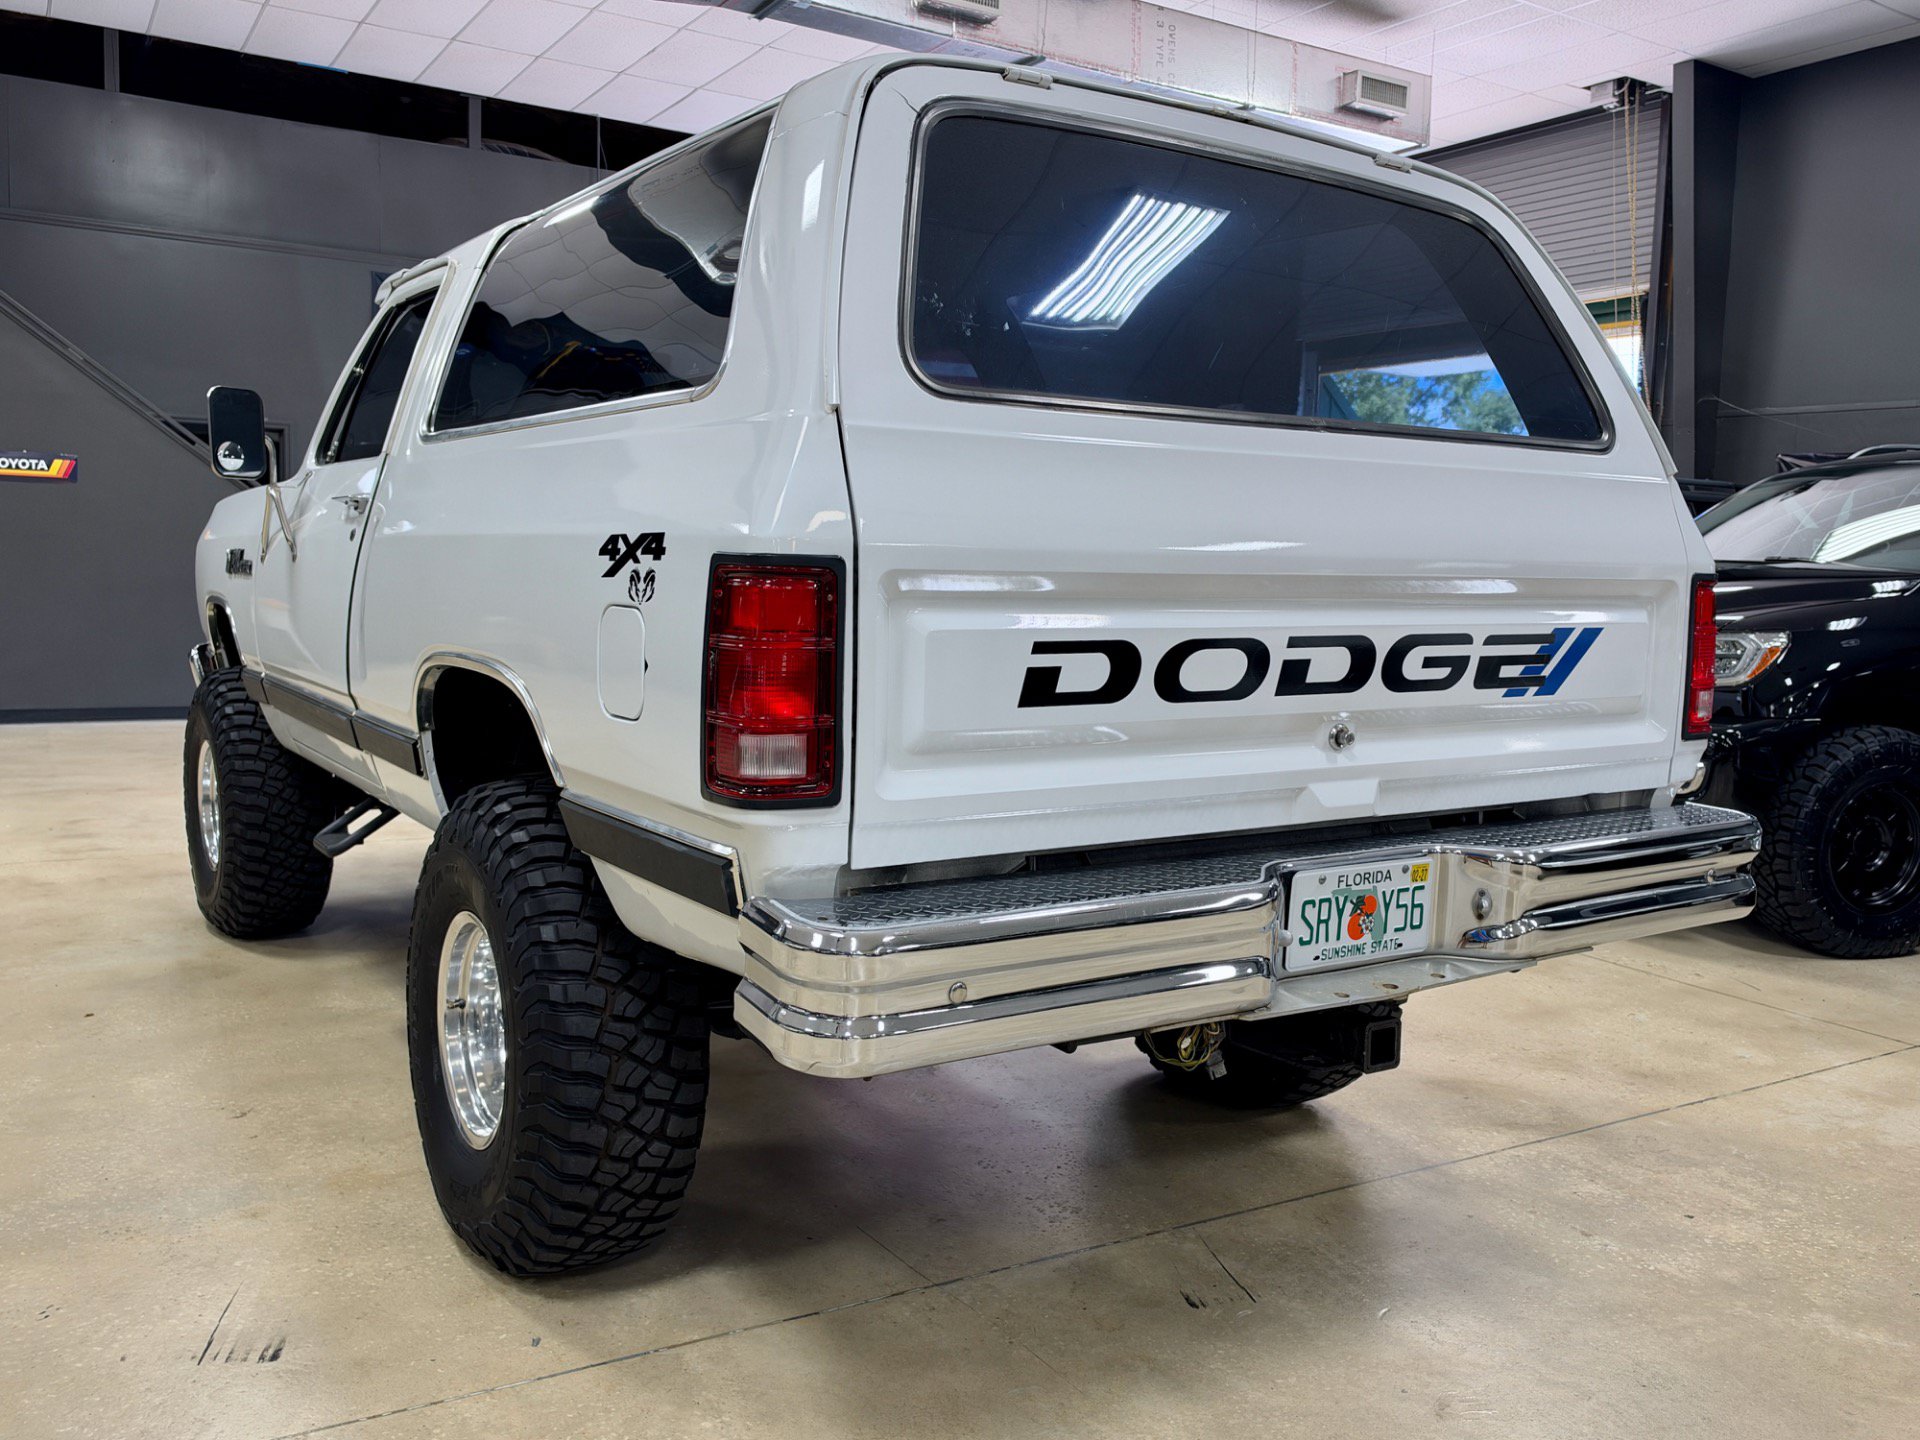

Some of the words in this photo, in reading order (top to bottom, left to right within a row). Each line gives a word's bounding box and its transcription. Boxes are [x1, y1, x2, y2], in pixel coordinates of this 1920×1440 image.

[1155, 37, 1165, 68] TYPE
[0, 457, 49, 471] OYOTA
[1017, 631, 1556, 709] DODGE
[1337, 869, 1393, 889] FLORIDA
[1381, 884, 1426, 935] Y56
[1321, 942, 1367, 961] SUNSHINE
[1370, 937, 1400, 955] STATE
